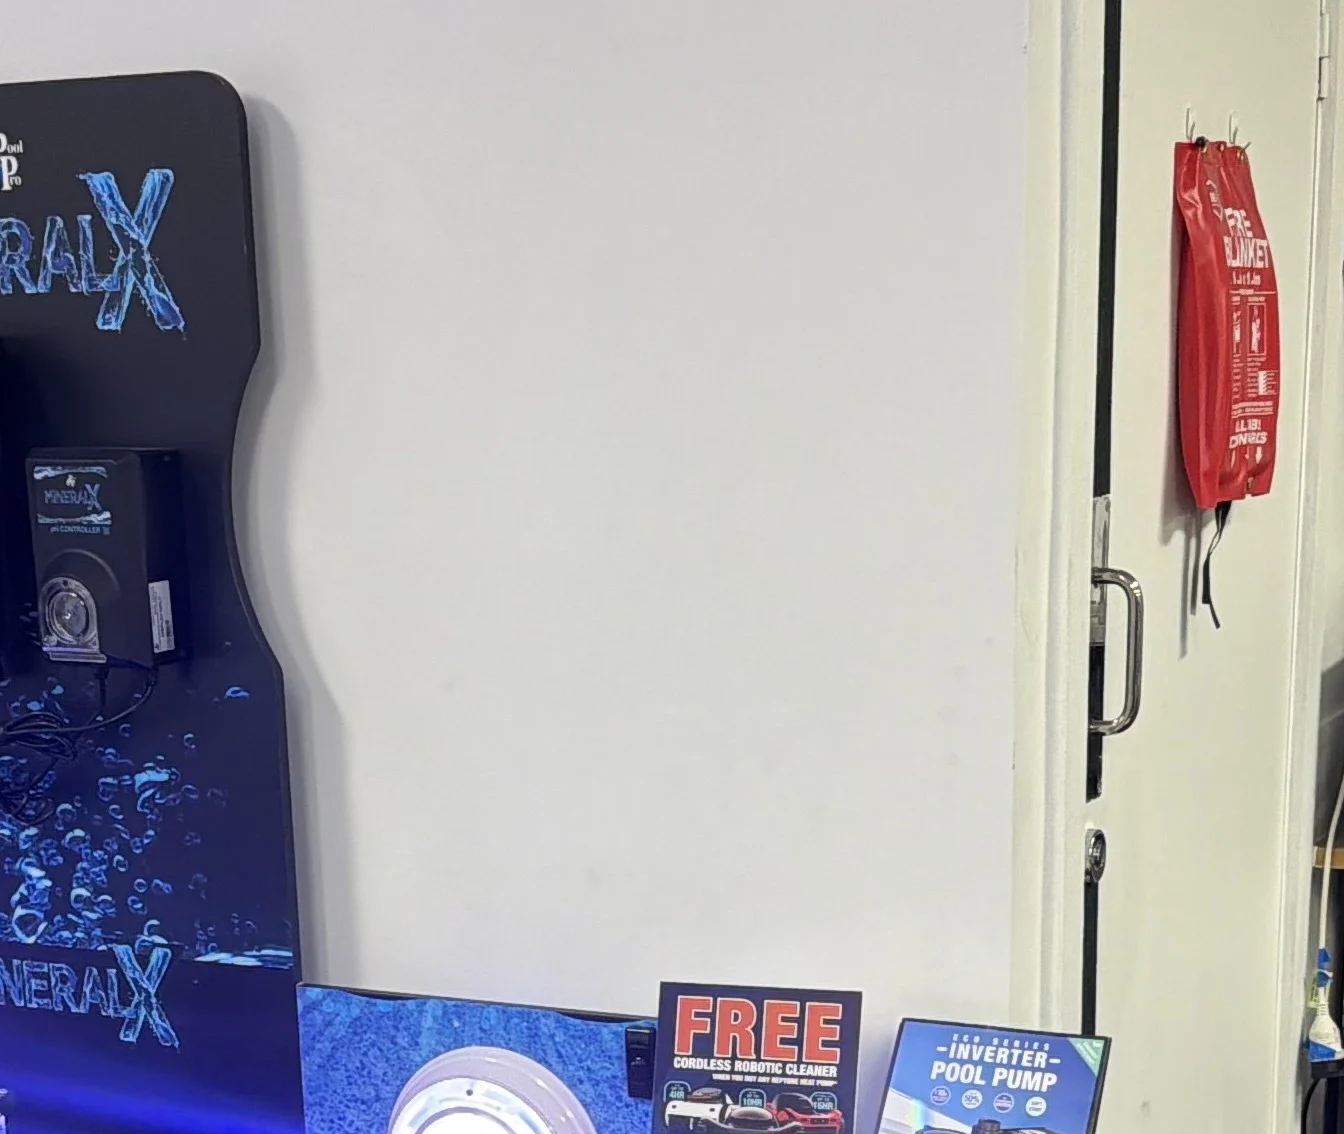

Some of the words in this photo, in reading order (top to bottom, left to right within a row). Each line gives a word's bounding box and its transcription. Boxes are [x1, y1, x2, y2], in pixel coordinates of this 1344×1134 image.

[0, 155, 23, 192] Pro
[674, 994, 843, 1064] FREE
[992, 1037, 1050, 1051] SERIES
[673, 1056, 731, 1072] CORDLESS
[734, 1060, 783, 1075] ROBOTIC
[785, 1063, 838, 1078] CLEANER
[929, 1060, 987, 1086] POOL
[991, 1067, 1058, 1093] PUMP
